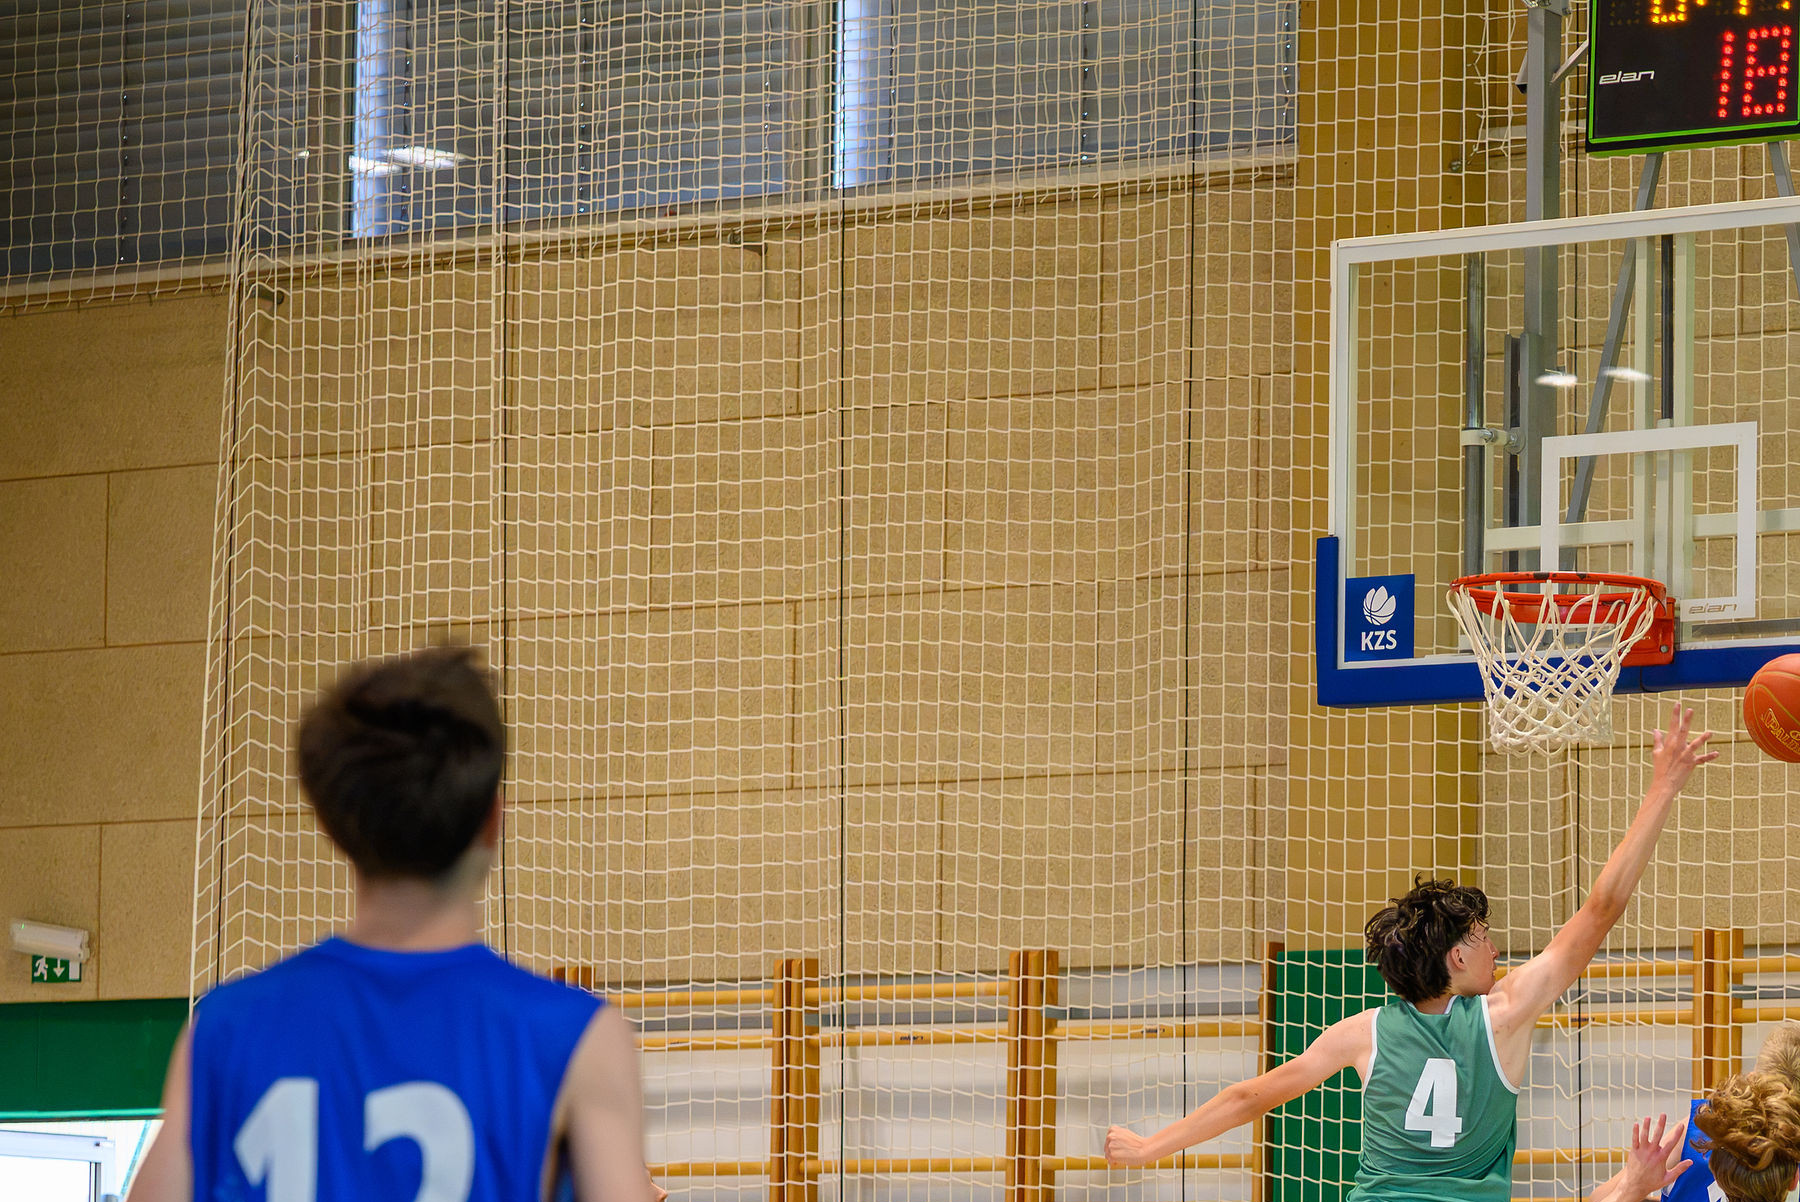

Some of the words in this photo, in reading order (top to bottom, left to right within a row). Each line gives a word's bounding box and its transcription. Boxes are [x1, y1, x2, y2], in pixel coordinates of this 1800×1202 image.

[1599, 69, 1655, 85] elan
[1714, 26, 1792, 119] 18
[1688, 602, 1738, 614] elan
[1361, 629, 1397, 651] KZS
[1405, 1058, 1462, 1147] 4
